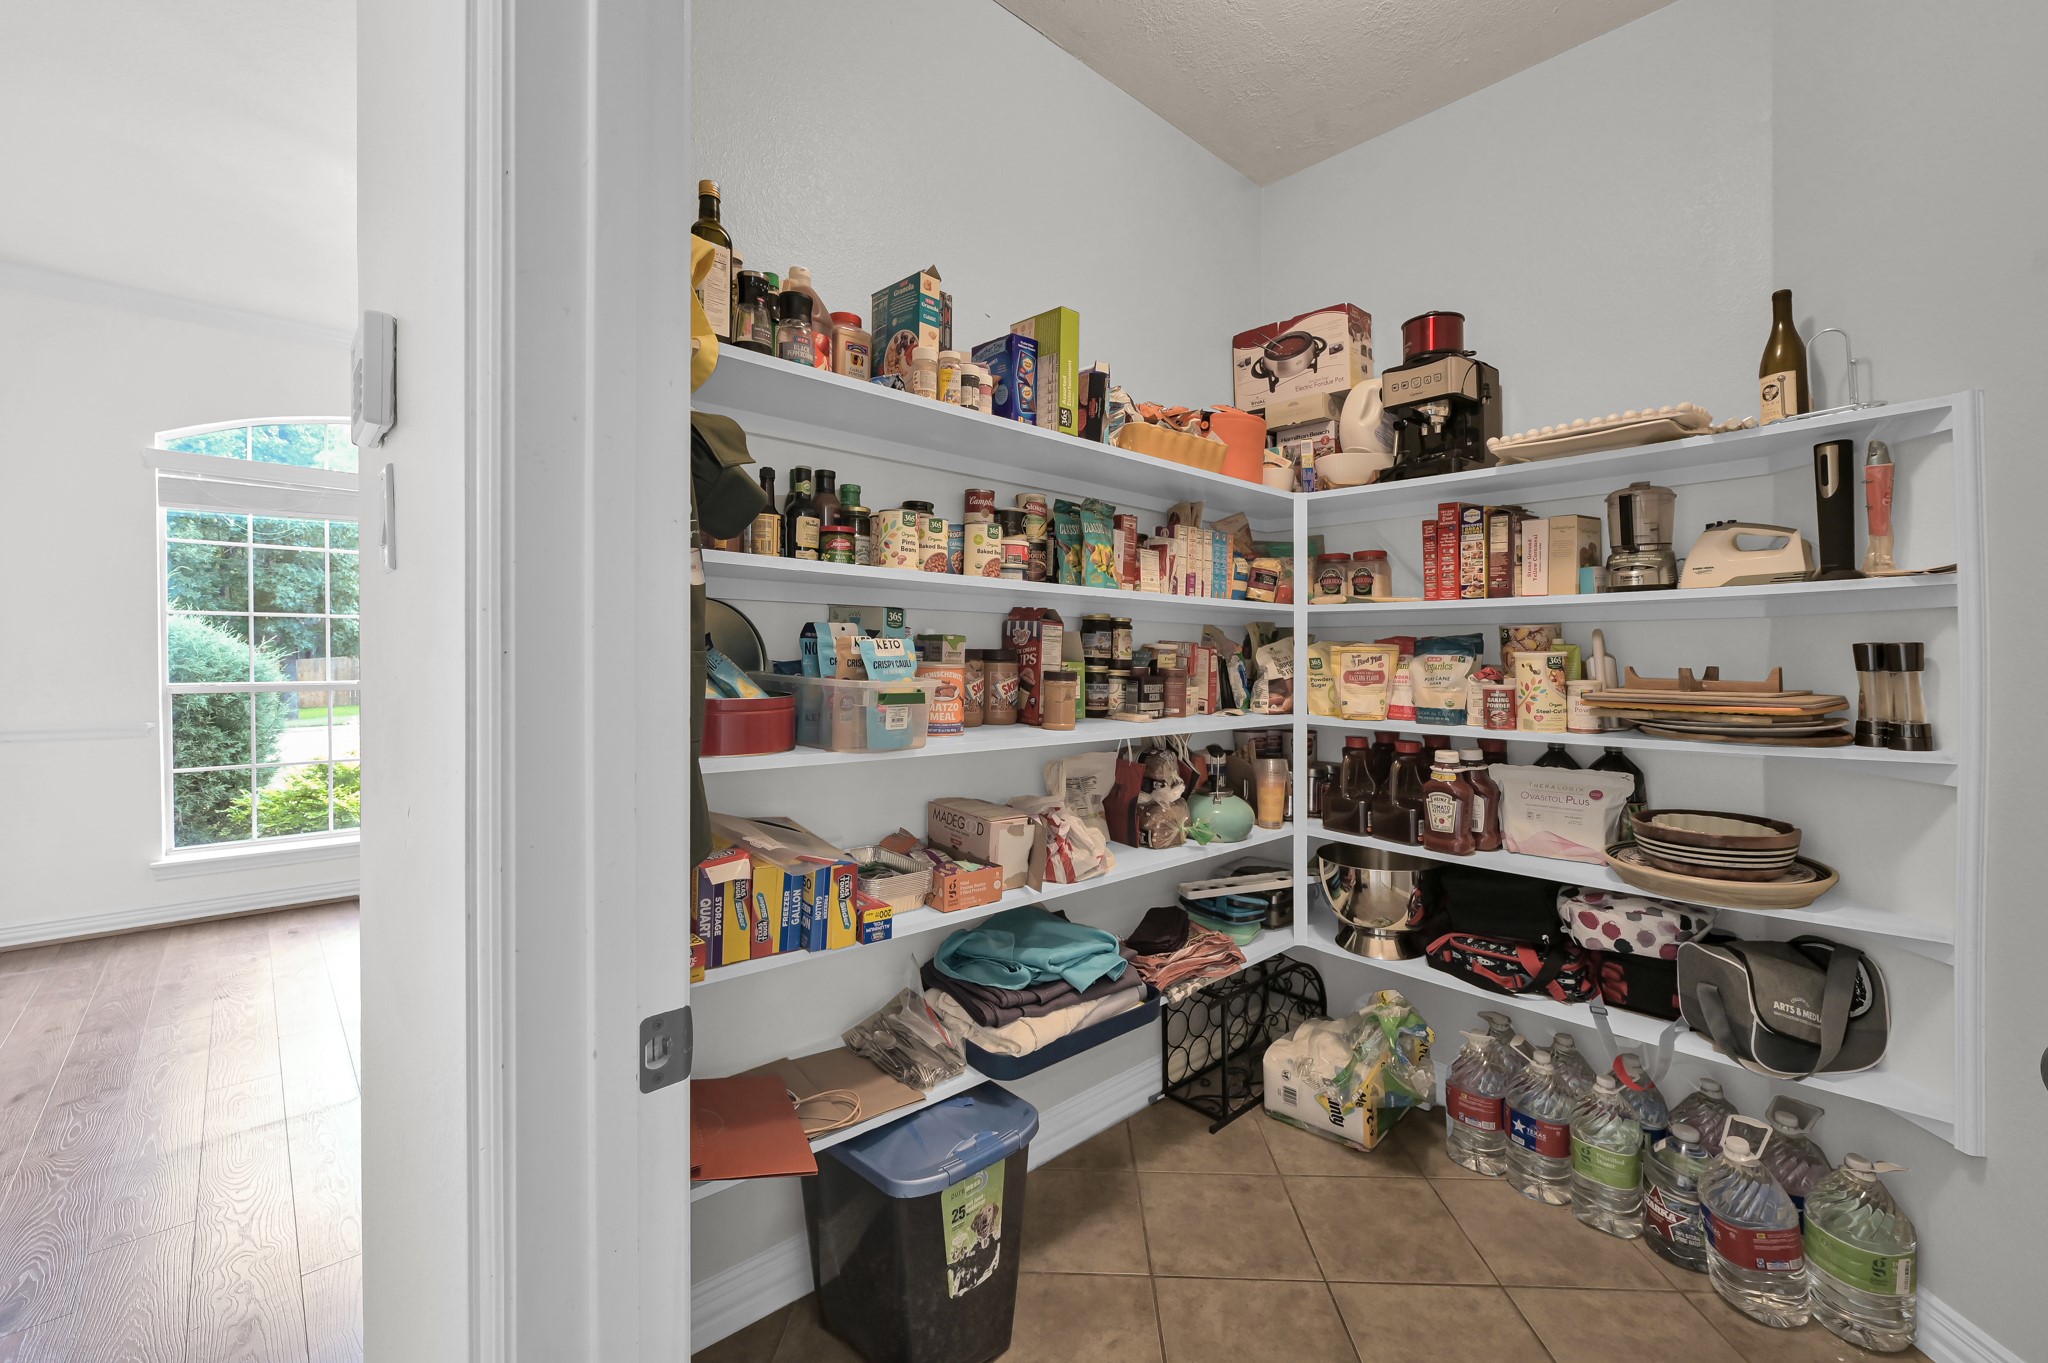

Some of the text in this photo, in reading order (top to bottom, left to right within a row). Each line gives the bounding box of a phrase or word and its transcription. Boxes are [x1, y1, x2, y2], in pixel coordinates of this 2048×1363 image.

[894, 283, 915, 297] Granola
[1295, 383, 1313, 392] Electric
[1314, 377, 1334, 388] Fondue
[1281, 428, 1330, 443] Hamilton Beach
[903, 514, 916, 522] 365
[930, 521, 942, 529] 365
[888, 612, 903, 622] 365
[876, 639, 901, 650] KETO
[873, 659, 912, 670] CRISPY CAULI
[1357, 654, 1383, 668] Red Mill
[1423, 661, 1453, 673] Organics
[1548, 657, 1562, 665] 365
[922, 670, 963, 681] ANISCHEWIT
[930, 712, 956, 721] MEAL
[1528, 782, 1584, 792] THERALOGIX
[1520, 790, 1590, 807] OVASITOL PLUS
[1431, 803, 1451, 811] TOMATO
[932, 808, 985, 836] MADEGOOD
[735, 900, 746, 928] Slider
[757, 895, 768, 919] Slider
[782, 890, 791, 927] FREEZER
[791, 889, 802, 925] GALLON
[815, 896, 823, 921] GALLON
[840, 901, 850, 926] Slider
[879, 909, 892, 919] 200
[699, 898, 712, 938] QUART
[714, 896, 723, 937] STORAGE
[866, 924, 891, 933] ALUMINUM
[1773, 1001, 1795, 1014] ARTS
[1796, 1007, 1802, 1016] &
[1526, 1127, 1547, 1140] TEXAS
[1596, 1152, 1625, 1166] Distilled
[1597, 1158, 1617, 1169] Water
[950, 1189, 966, 1200] pure
[951, 1205, 966, 1224] 25
